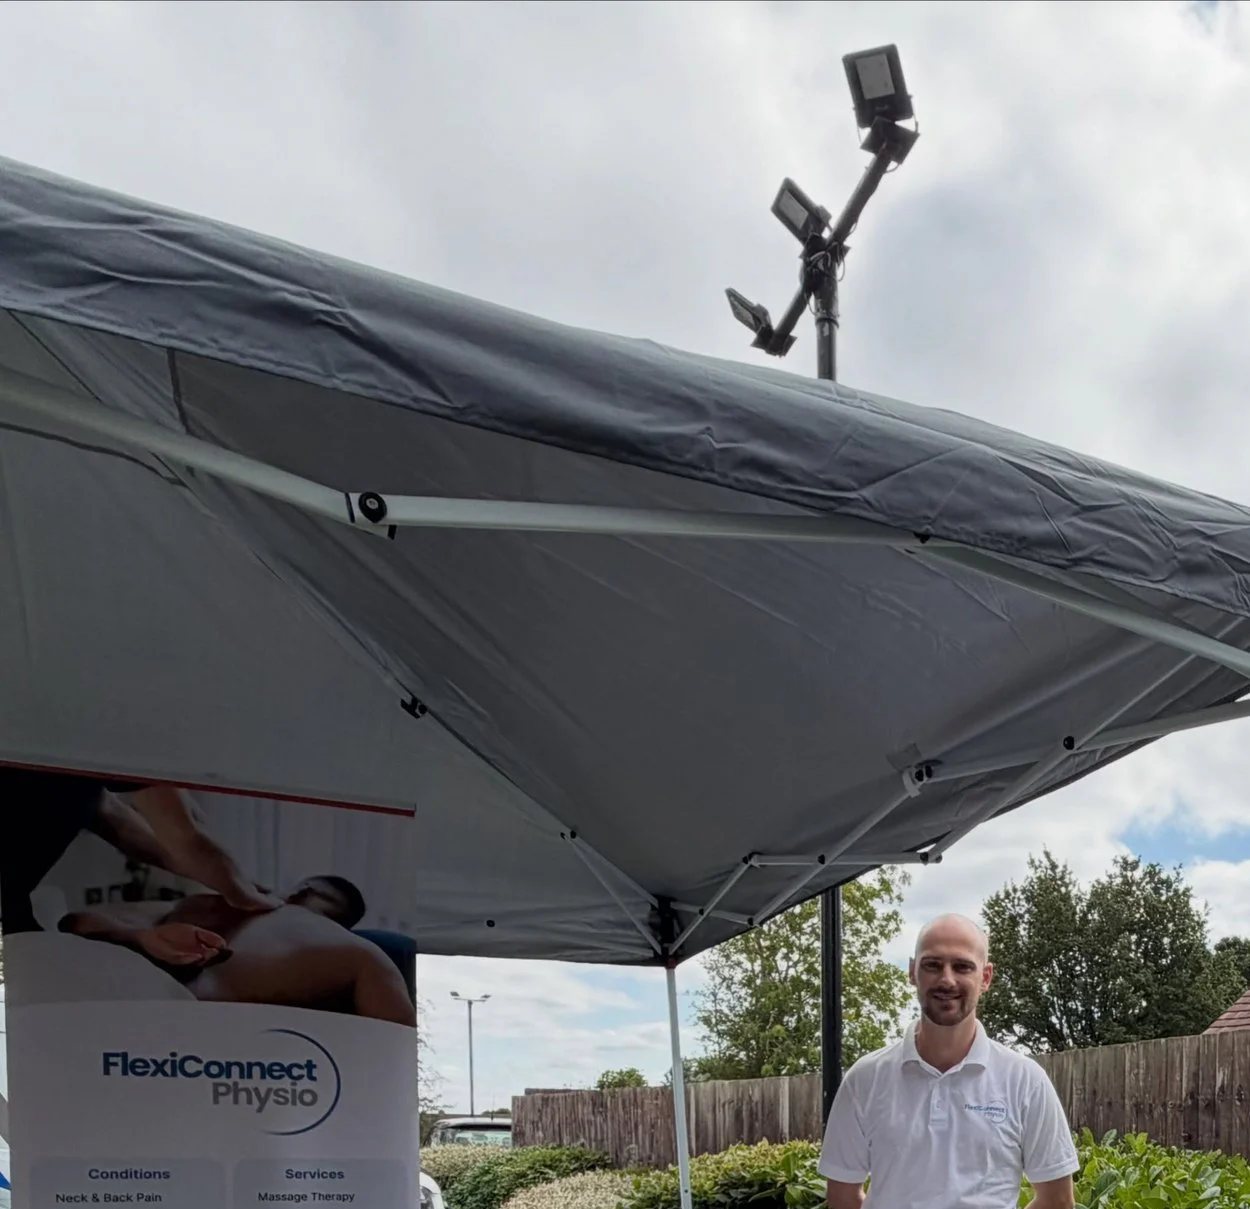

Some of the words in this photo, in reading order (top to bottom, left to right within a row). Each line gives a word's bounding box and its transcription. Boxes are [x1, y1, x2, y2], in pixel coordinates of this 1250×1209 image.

[102, 1051, 317, 1082] FlexiConnect
[212, 1081, 318, 1113] Physio
[88, 1168, 171, 1180] Conditions
[285, 1168, 345, 1179] Services
[55, 1193, 88, 1203] Neck
[91, 1193, 100, 1203] &
[103, 1193, 134, 1203] Back
[136, 1192, 162, 1202] Pain
[257, 1192, 308, 1203] Massage
[311, 1192, 355, 1203] Therapy
